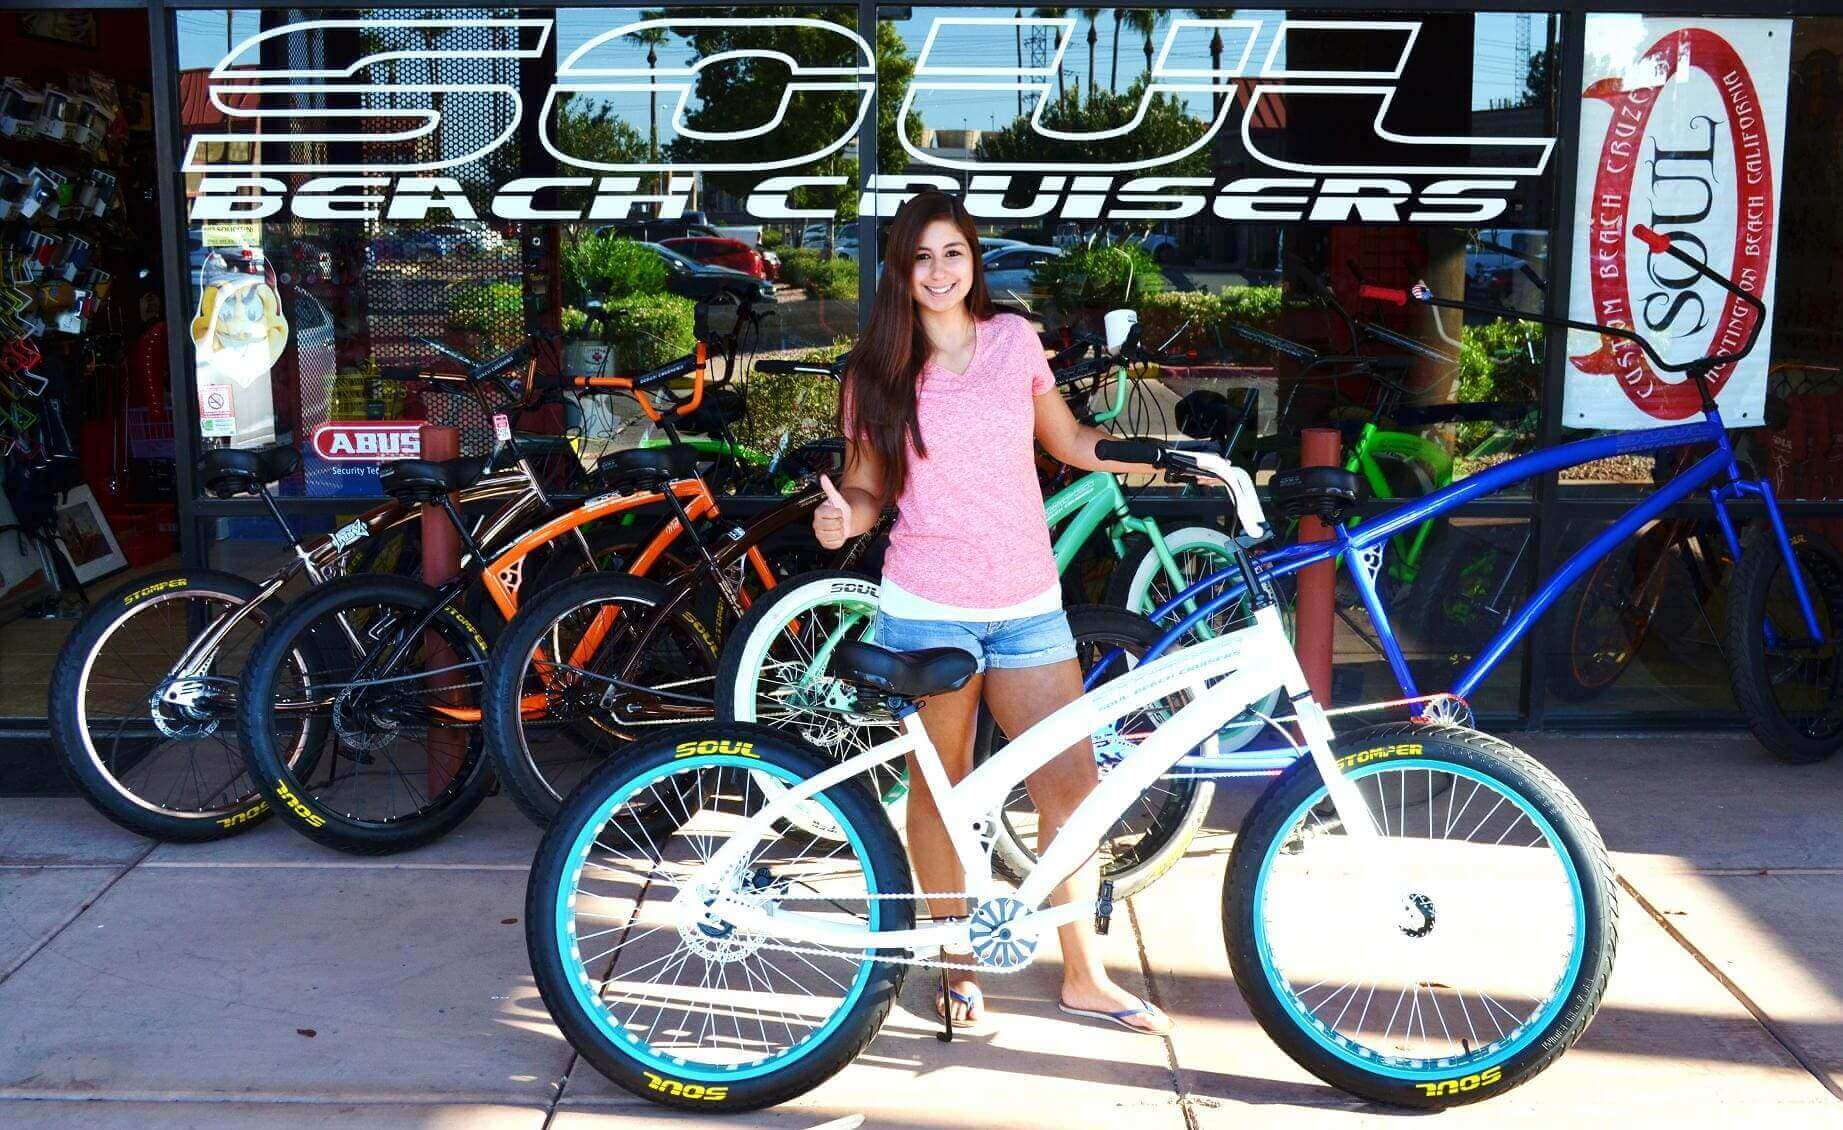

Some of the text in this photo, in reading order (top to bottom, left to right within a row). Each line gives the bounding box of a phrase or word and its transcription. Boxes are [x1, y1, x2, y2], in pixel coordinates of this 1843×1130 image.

[181, 18, 1556, 177] SOUL
[1722, 70, 1763, 184] CALIFORNIA
[190, 175, 1517, 223] BEACH CRUISERS
[1600, 194, 1623, 279] BEACH
[1645, 115, 1724, 338] SOUL
[1745, 195, 1764, 256] BEACH
[1602, 298, 1653, 399] CUSTOM
[329, 433, 420, 454] ABUS
[332, 466, 365, 476] Security
[123, 578, 188, 605] STOMPER
[831, 583, 880, 599] SOUL
[674, 740, 761, 758] SOUL
[1335, 744, 1423, 769] STOMPER
[216, 800, 271, 828] SOUL
[276, 778, 327, 828] SOUL
[643, 1071, 729, 1101] SOUL
[1415, 1065, 1503, 1097] SOUL
